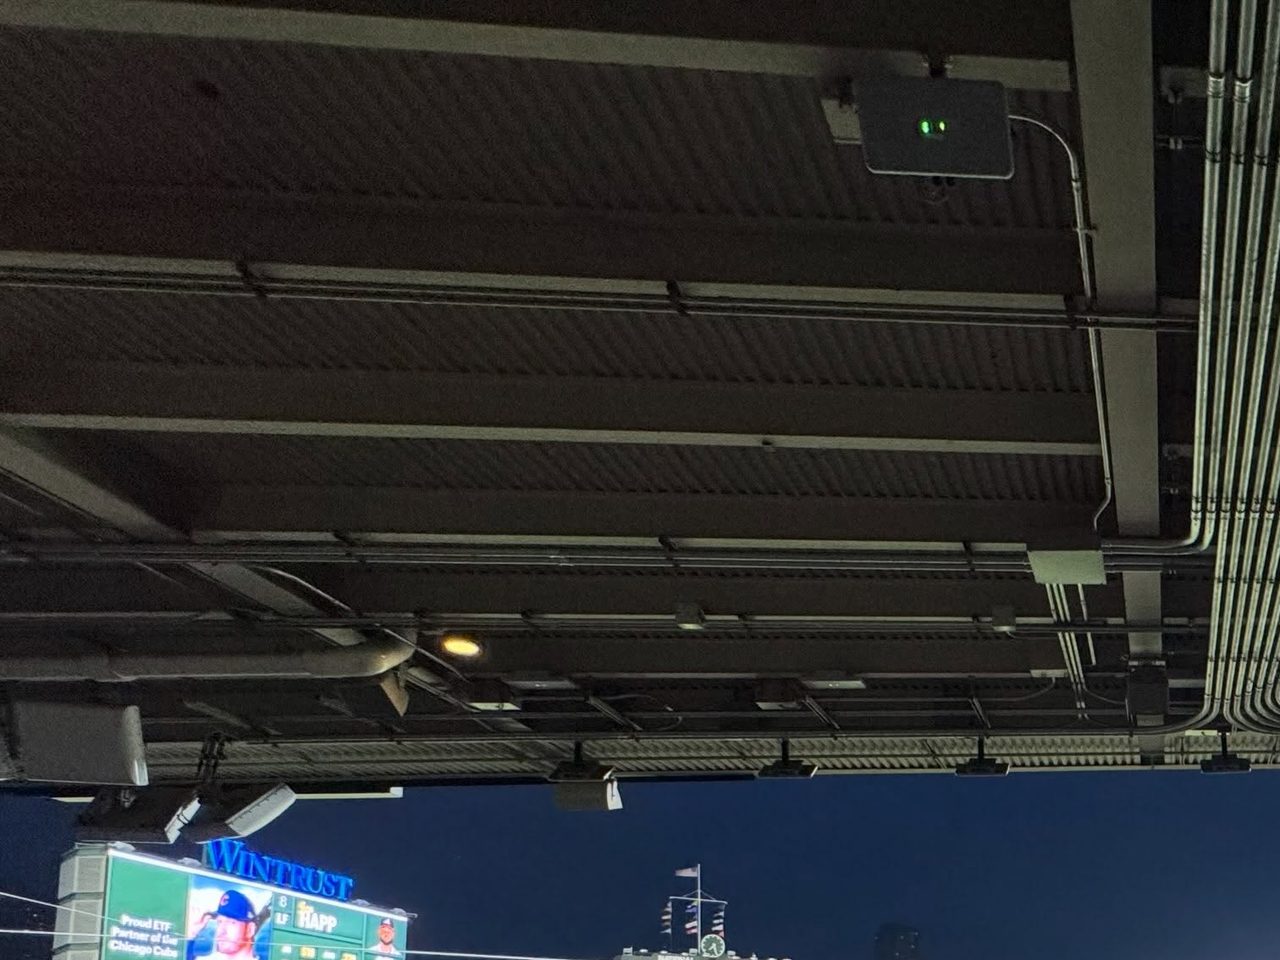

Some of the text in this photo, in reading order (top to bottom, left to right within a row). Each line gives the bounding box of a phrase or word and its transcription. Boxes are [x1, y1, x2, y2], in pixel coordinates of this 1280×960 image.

[205, 838, 353, 900] WINTRUST
[280, 896, 287, 907] 8
[121, 914, 171, 932] Proud ETF
[300, 912, 337, 932] HAPP
[111, 926, 178, 945] Partner of the
[110, 940, 178, 957] Chicago Cubs
